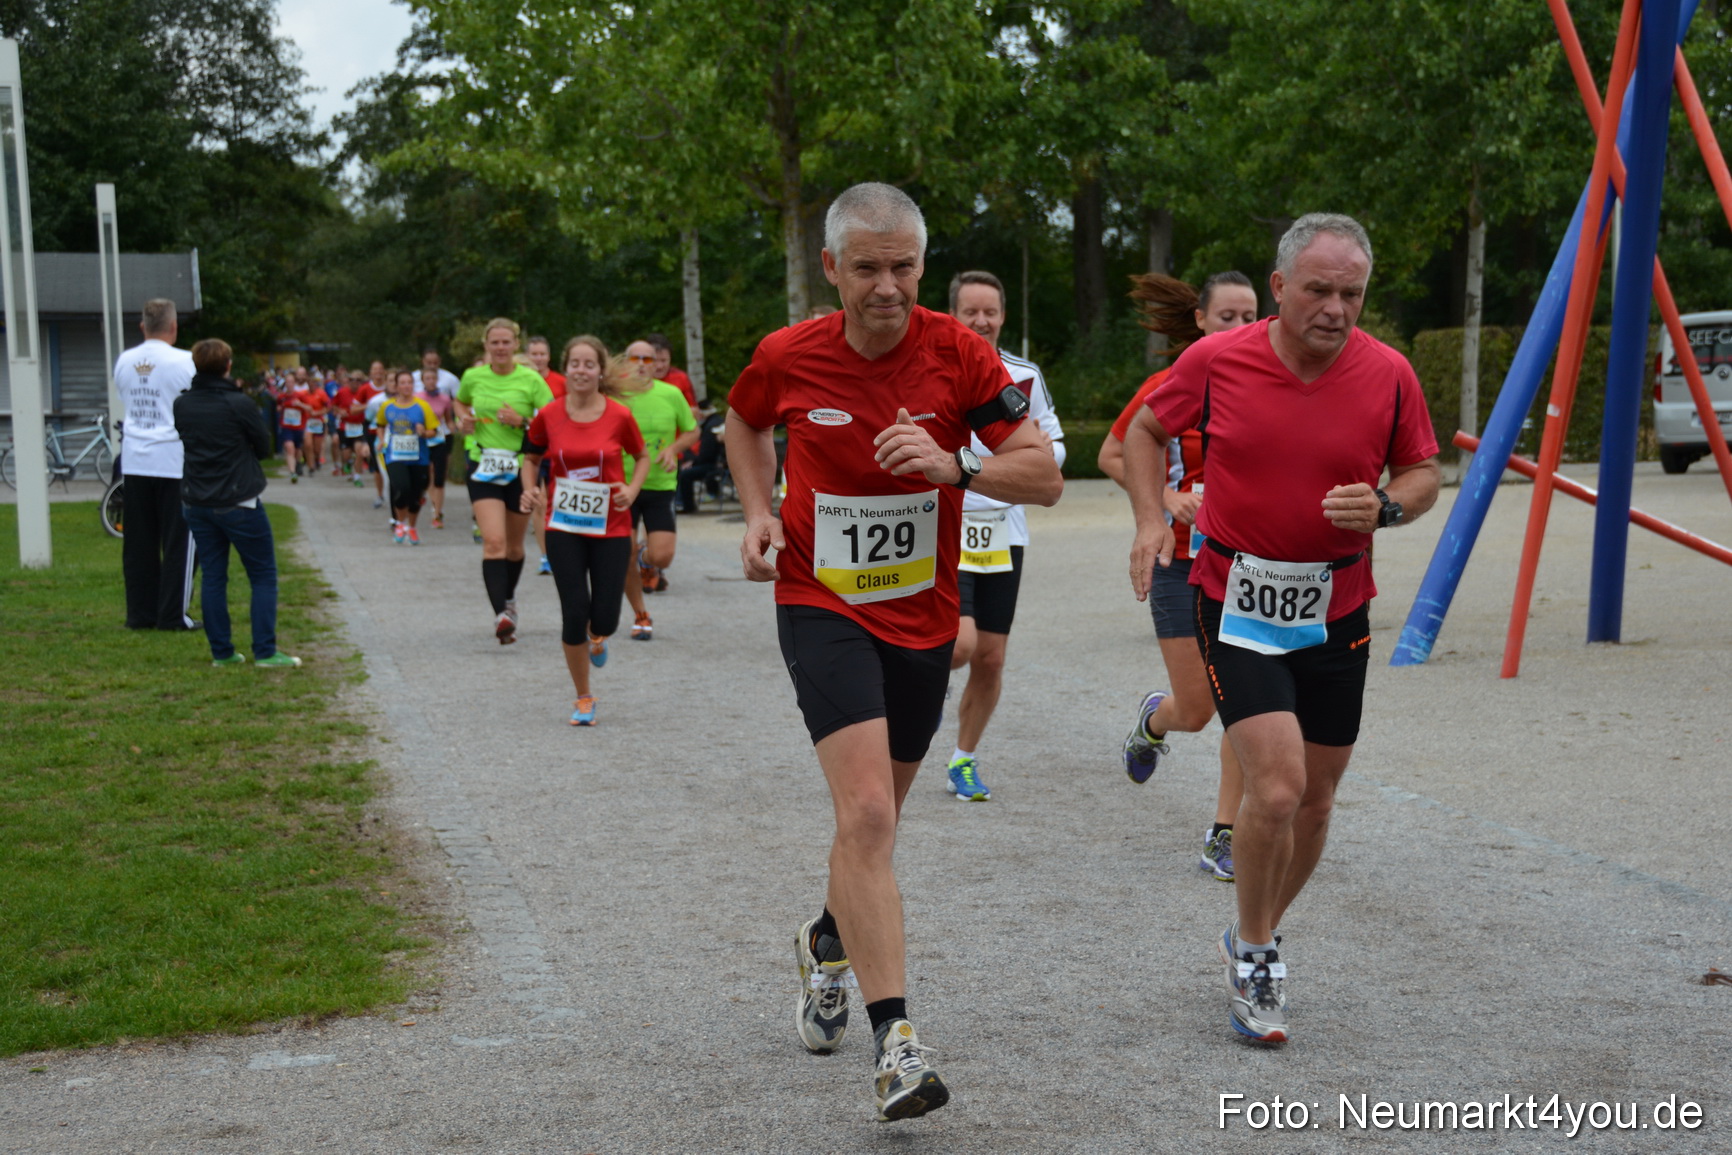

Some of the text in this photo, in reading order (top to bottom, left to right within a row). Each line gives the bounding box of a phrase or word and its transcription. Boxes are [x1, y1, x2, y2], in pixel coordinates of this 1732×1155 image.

[483, 457, 514, 473] 2344
[558, 491, 604, 515] 2452
[818, 504, 918, 519] PARTL Neumarkt
[842, 521, 915, 564] 129
[966, 526, 992, 549] 89
[820, 559, 826, 567] D
[1234, 560, 1316, 582] PARTL Neumarkt
[856, 573, 900, 590] Claus
[1237, 578, 1322, 622] 3082
